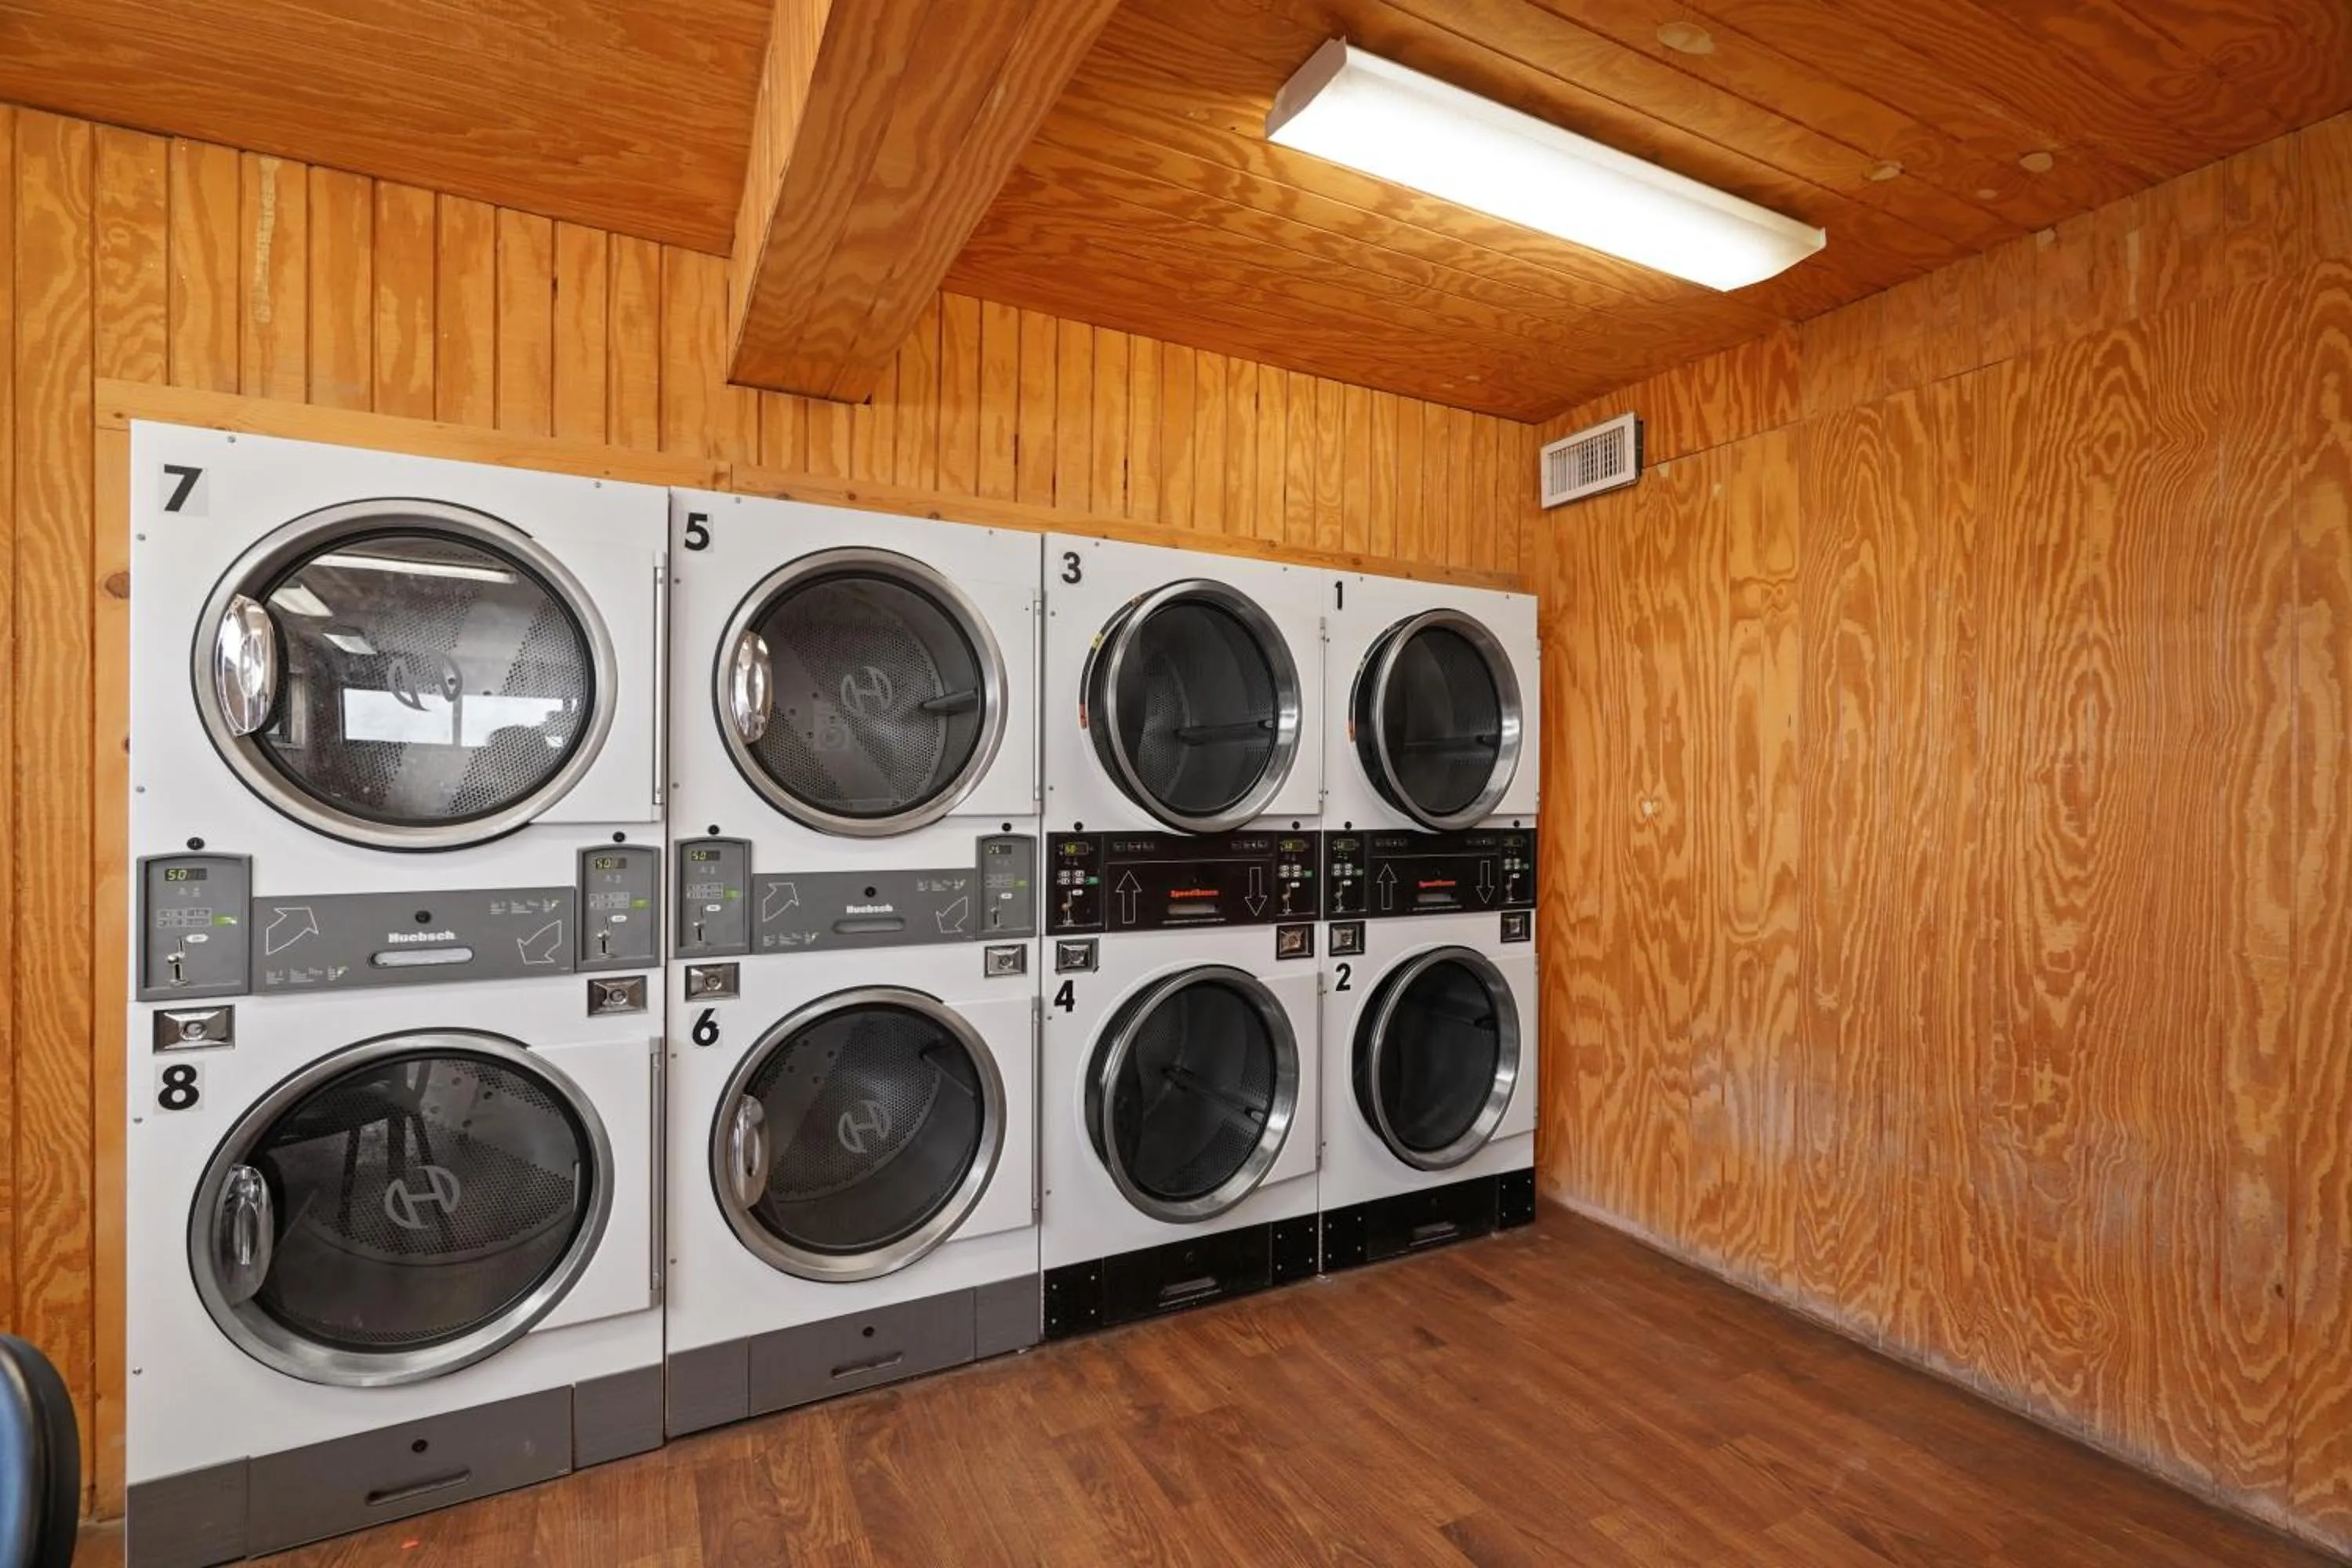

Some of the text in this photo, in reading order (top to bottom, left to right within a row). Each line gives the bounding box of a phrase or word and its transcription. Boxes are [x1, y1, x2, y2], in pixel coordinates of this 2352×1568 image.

[164, 463, 202, 512] 7
[684, 512, 711, 551] 5
[1062, 551, 1082, 584] 3
[1334, 580, 1344, 611] 1
[168, 869, 187, 880] 50
[388, 930, 456, 943] Huebsch
[1335, 962, 1352, 992] 2
[1054, 979, 1076, 1013] 4
[691, 1007, 720, 1047] 6
[158, 1064, 200, 1111] 8
